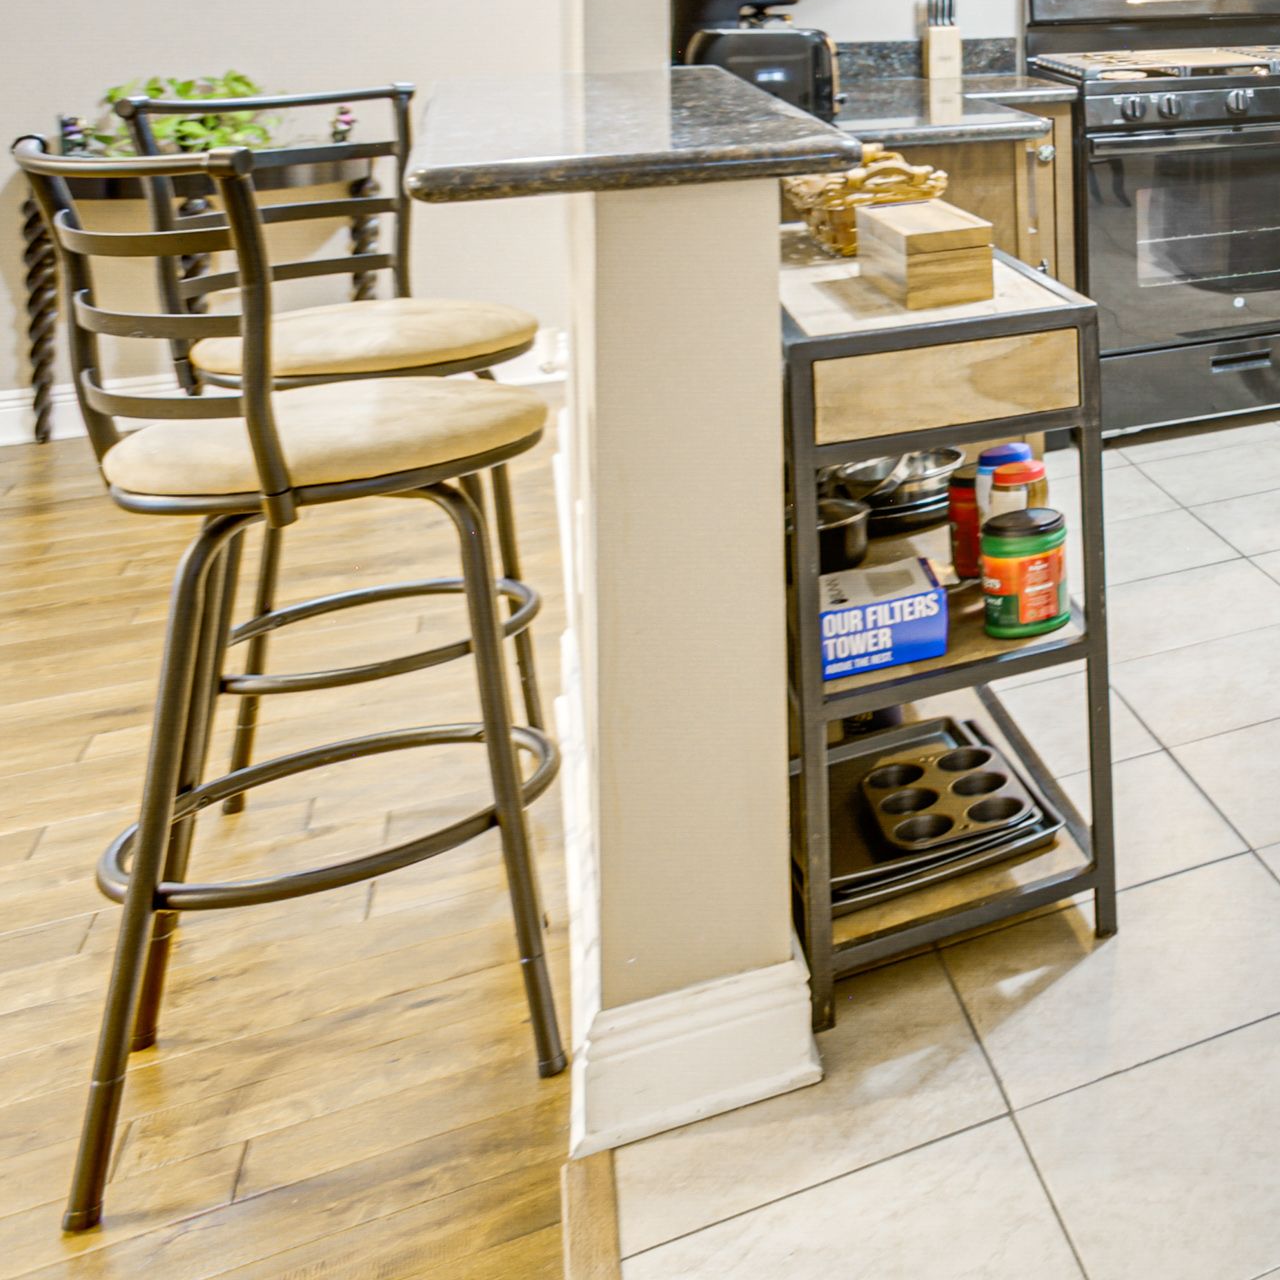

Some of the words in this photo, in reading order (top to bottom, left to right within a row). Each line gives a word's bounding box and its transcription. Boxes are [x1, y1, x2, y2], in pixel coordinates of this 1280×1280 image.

[823, 609, 864, 638] OUR
[865, 592, 940, 629] FILTERS
[823, 627, 893, 661] TOWER
